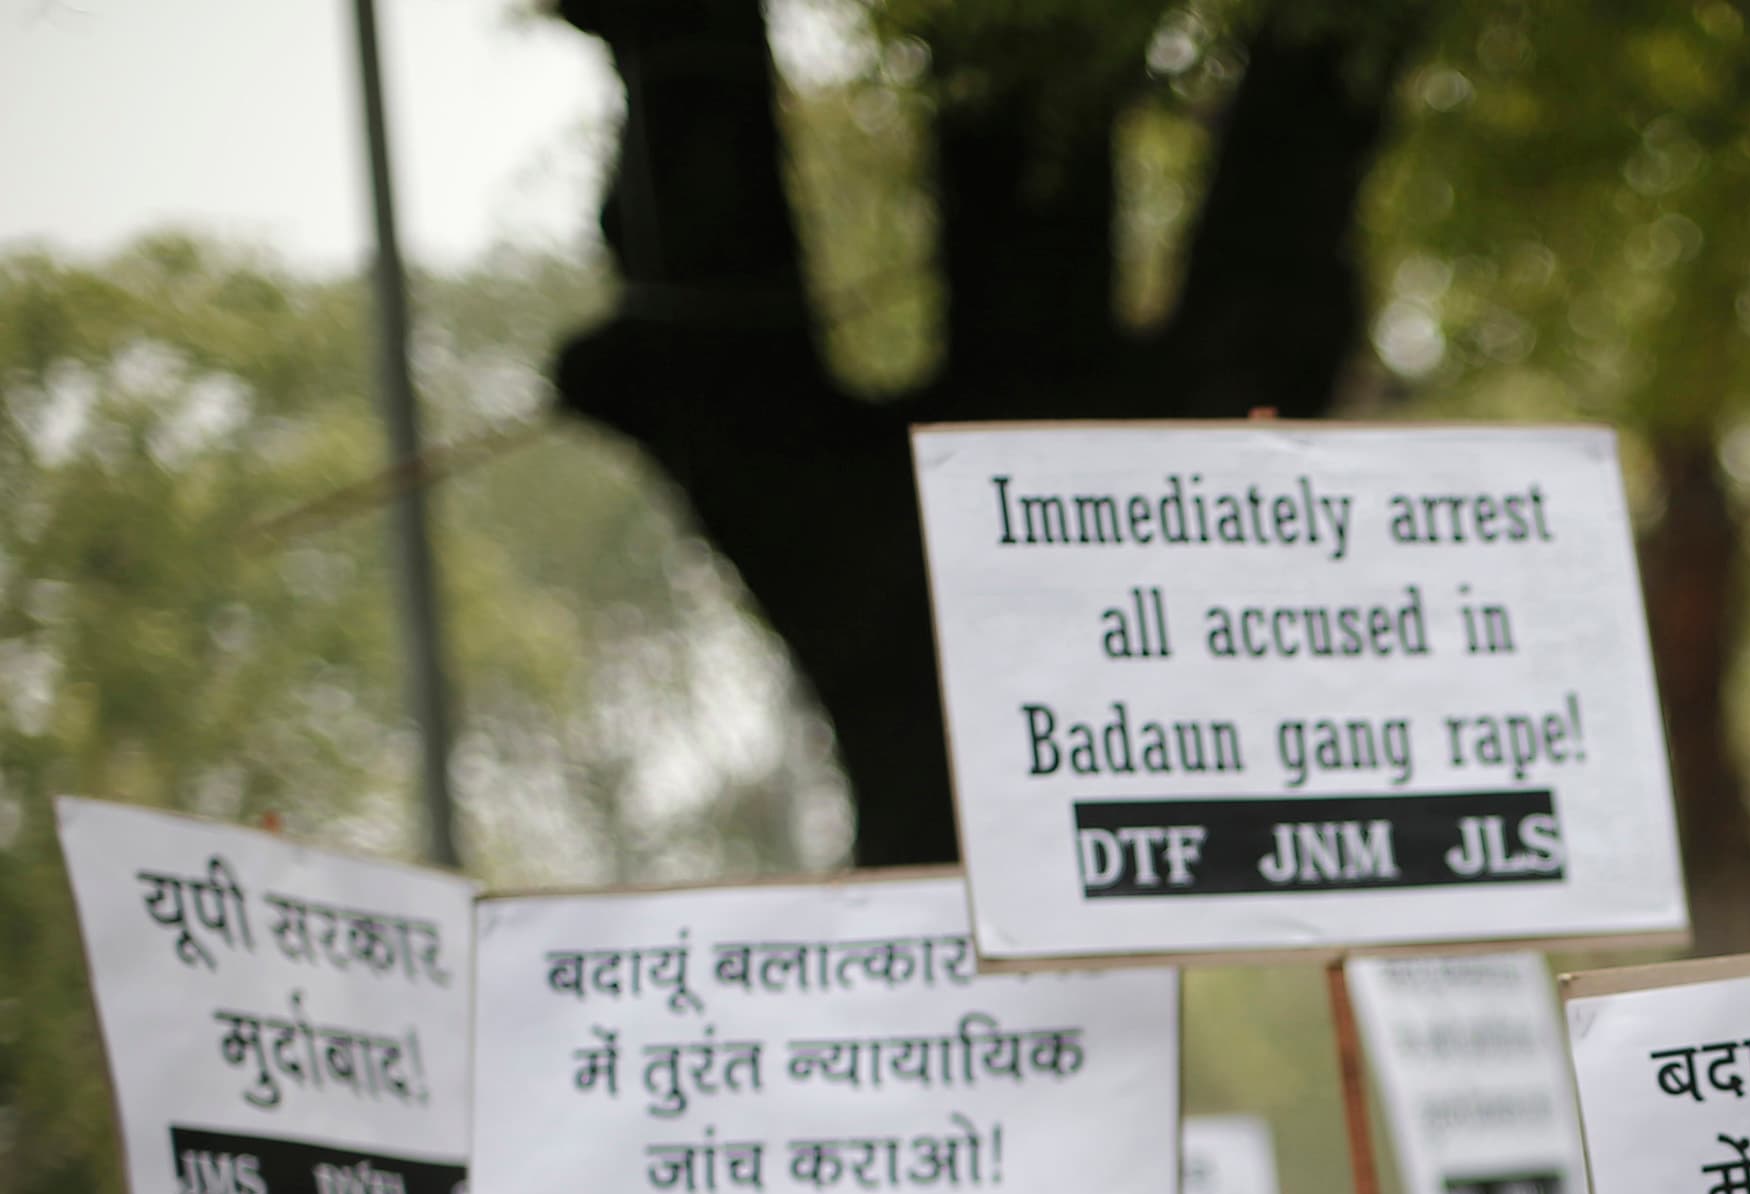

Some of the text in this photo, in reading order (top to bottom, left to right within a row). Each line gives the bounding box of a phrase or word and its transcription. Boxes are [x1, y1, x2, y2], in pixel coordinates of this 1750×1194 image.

[992, 476, 1553, 558] Immediately arrest
[1100, 586, 1517, 659] all accused in
[1020, 693, 1588, 786] Badaun gang rape!
[1080, 813, 1564, 888] DTF JNM JLS
[136, 855, 454, 988] यूपी सरकार
[545, 928, 704, 1013] बदायूं
[572, 1024, 621, 1098] में
[642, 1026, 765, 1117] तुरंत
[644, 1126, 766, 1194] जांच
